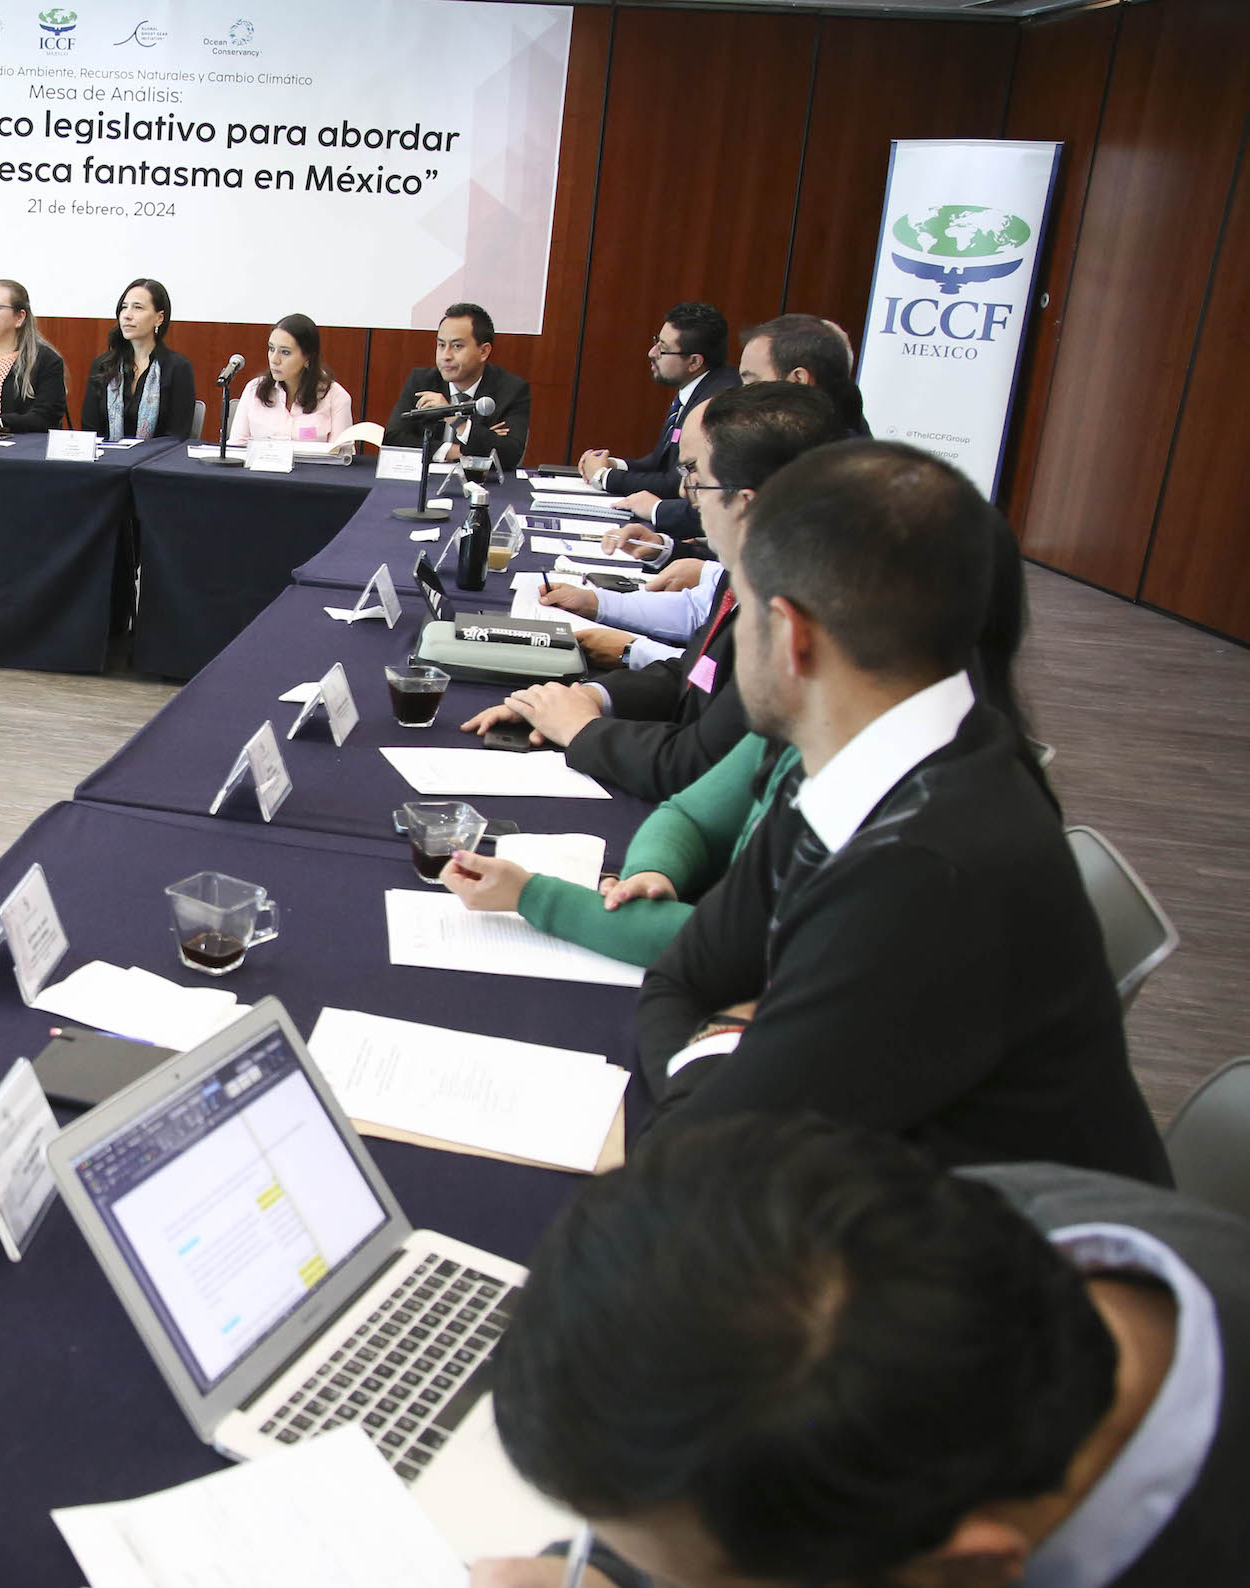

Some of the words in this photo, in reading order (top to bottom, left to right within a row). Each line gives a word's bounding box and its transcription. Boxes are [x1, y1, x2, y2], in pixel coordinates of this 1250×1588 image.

[39, 37, 76, 50] ICCF
[212, 48, 259, 57] Conservancy
[17, 66, 76, 78] Ambiente,
[80, 68, 134, 79] Recursos
[138, 70, 195, 81] Naturales
[198, 74, 205, 83] y
[208, 72, 254, 83] Cambio
[258, 73, 312, 85] Climático
[30, 85, 76, 100] Mesa
[83, 85, 105, 100] de
[111, 87, 182, 103] Análisis:
[46, 110, 215, 144] legislativo
[227, 124, 306, 148] para
[318, 120, 460, 151] abordar
[83, 156, 243, 188] fantasma
[255, 170, 294, 190] en
[305, 165, 437, 195] México”
[28, 199, 41, 213] 21
[48, 200, 65, 214] de
[72, 200, 128, 217] febrero,
[134, 202, 175, 216] 2024
[880, 297, 1013, 341] ICCF
[901, 342, 978, 360] MEXICO
